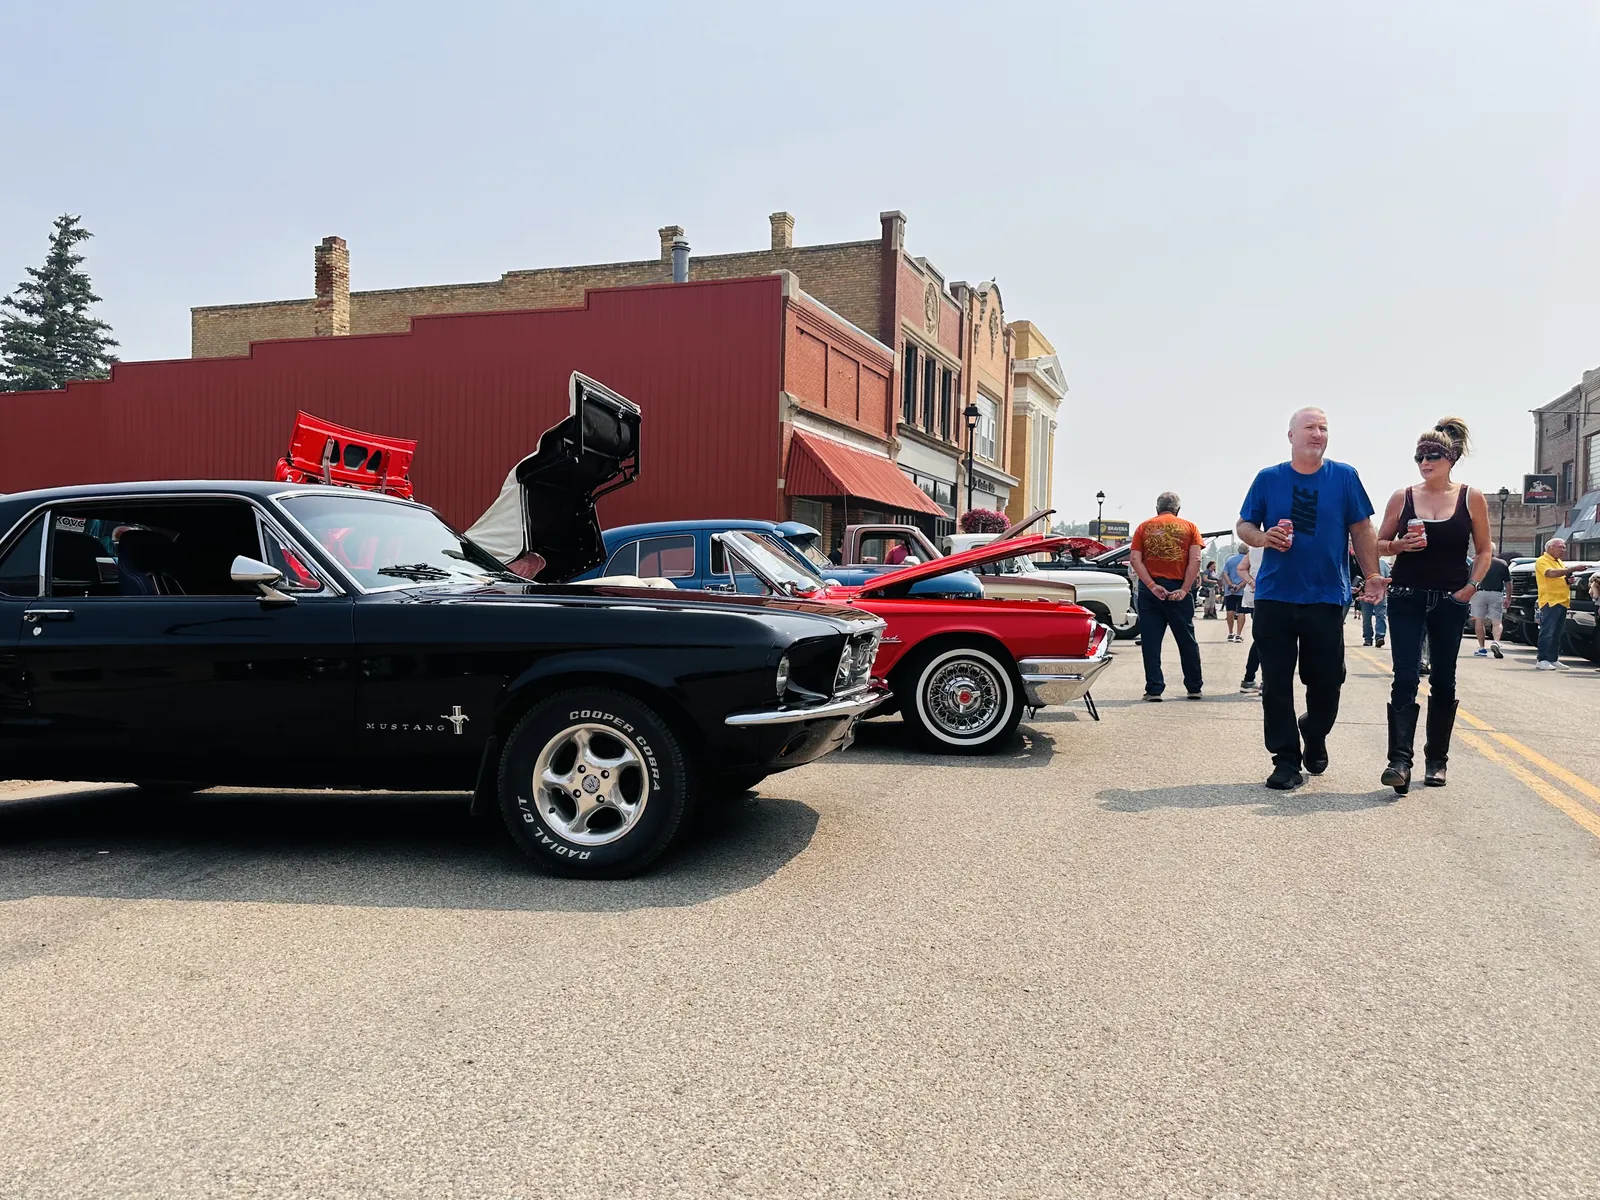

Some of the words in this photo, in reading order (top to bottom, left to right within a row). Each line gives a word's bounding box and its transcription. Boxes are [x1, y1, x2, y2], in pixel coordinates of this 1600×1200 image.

[1291, 485, 1318, 537] NIKE
[366, 723, 445, 731] MUSTANG
[569, 709, 635, 733] COOPER
[636, 735, 661, 791] COBRA
[517, 796, 535, 823] G/T
[535, 826, 592, 860] RADIAL
